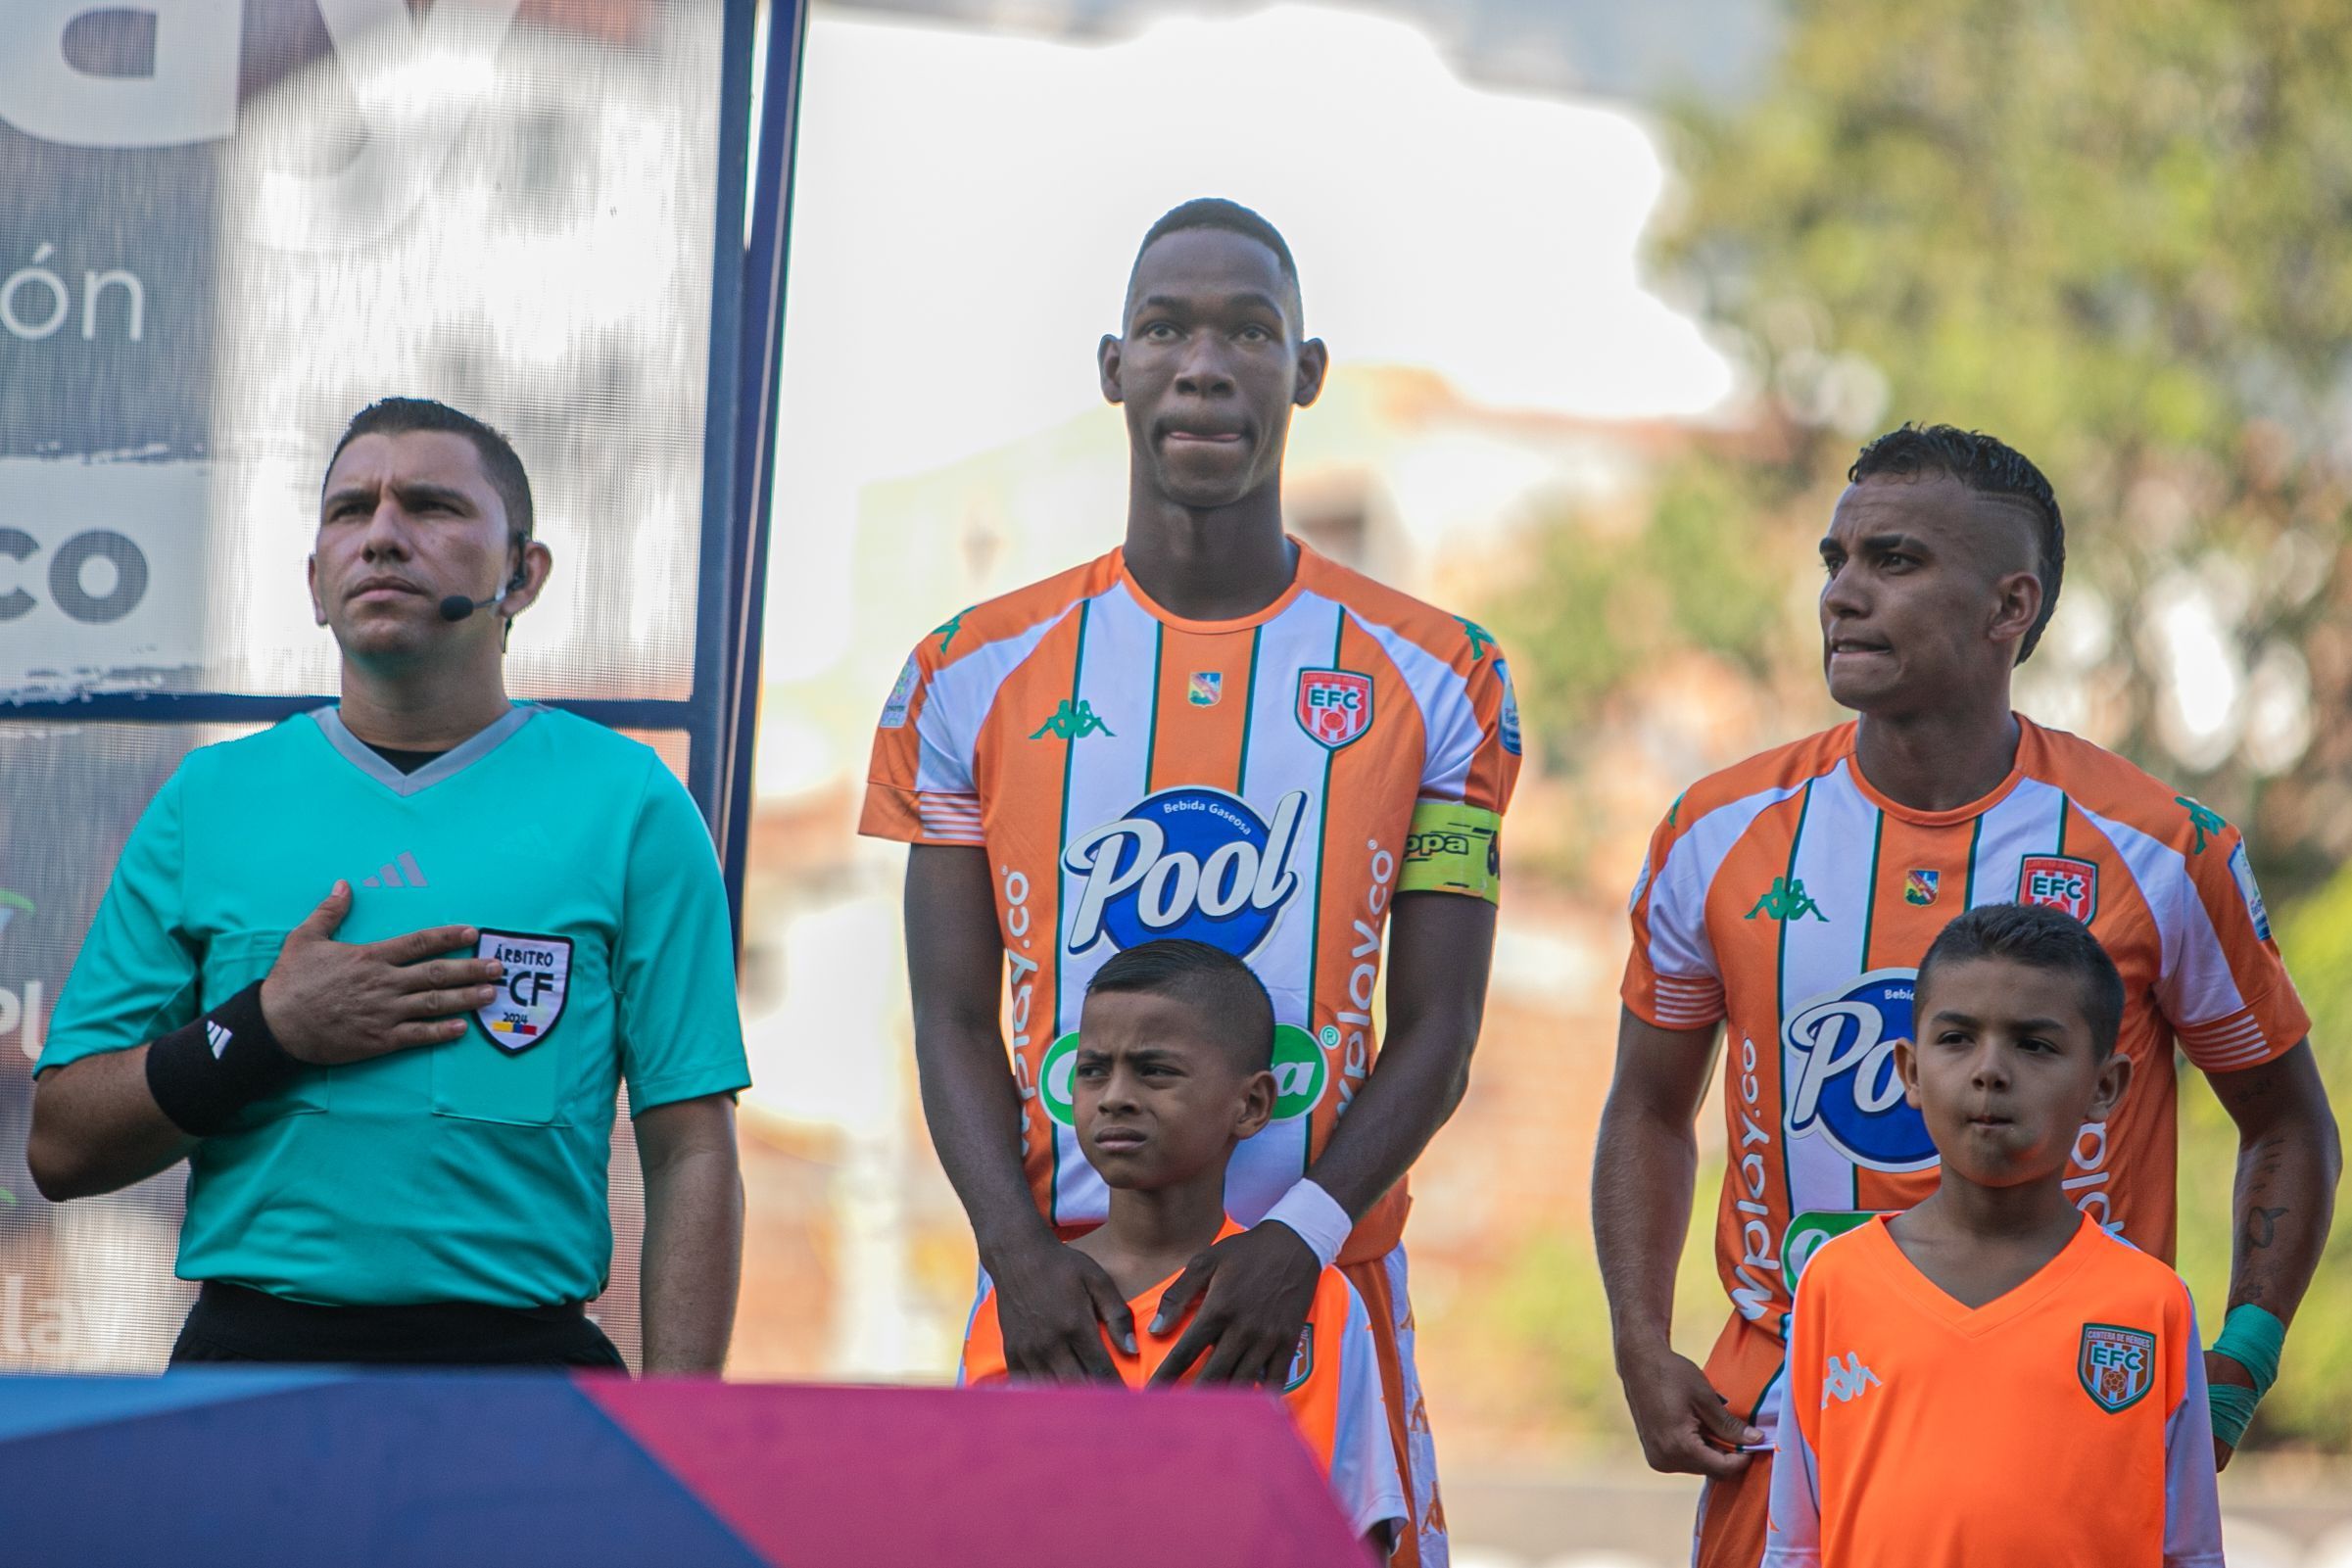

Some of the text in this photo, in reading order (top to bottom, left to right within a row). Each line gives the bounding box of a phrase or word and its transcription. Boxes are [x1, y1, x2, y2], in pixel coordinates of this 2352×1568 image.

[0, 243, 145, 342] ón
[1310, 688, 1359, 710] EFC
[1163, 800, 1252, 835] Bebida Gaseosa
[1063, 789, 1309, 954] Pool
[2033, 876, 2083, 900] EFC
[495, 943, 554, 967] ÁRBITRO
[503, 1012, 528, 1024] 2024
[2092, 1347, 2141, 1371] EFC
